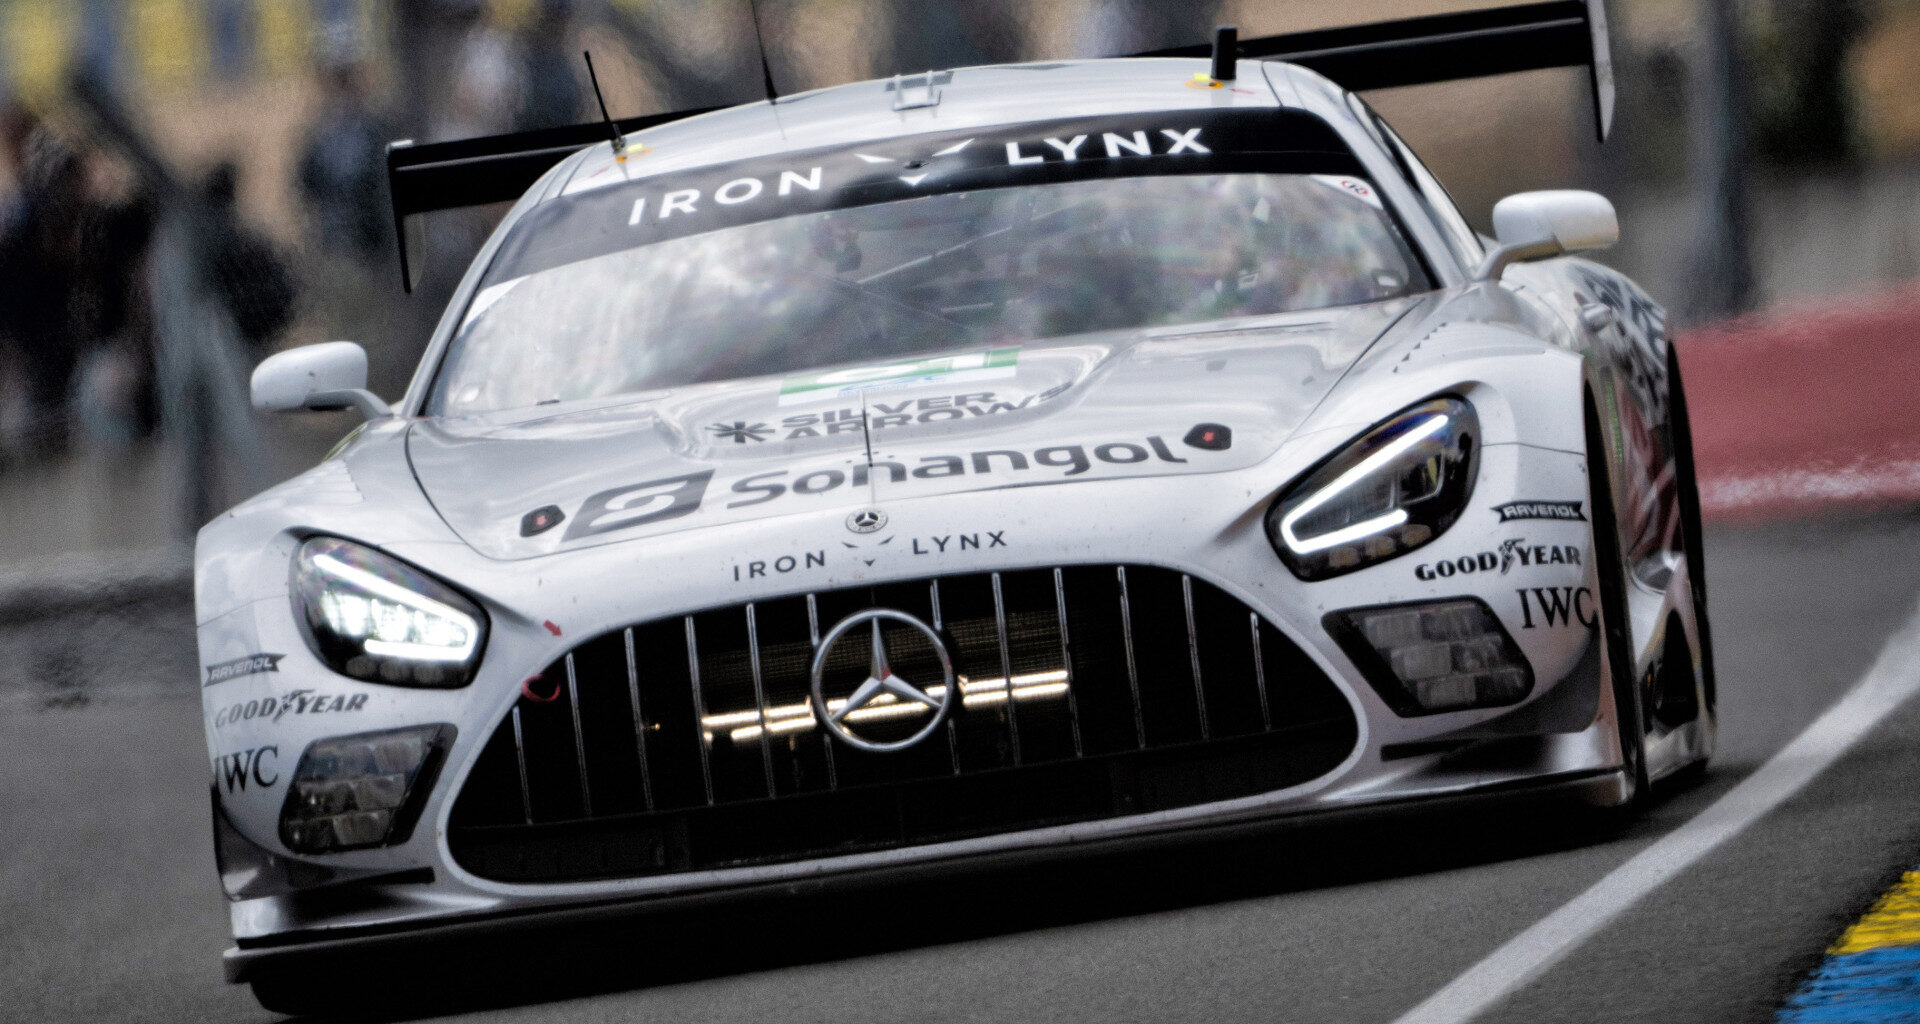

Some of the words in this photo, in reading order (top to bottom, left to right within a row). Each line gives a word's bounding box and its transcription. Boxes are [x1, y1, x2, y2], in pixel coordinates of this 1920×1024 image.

[628, 166, 823, 226] IRON
[1005, 128, 1212, 166] LYNX
[781, 391, 998, 427] SILVER
[726, 435, 1188, 510] Sonangol
[1502, 504, 1580, 519] RAVENOL
[733, 550, 826, 582] IRON
[912, 530, 1008, 555] LYNX
[1414, 544, 1582, 582] GOODYEAR
[1515, 586, 1600, 630] IWC
